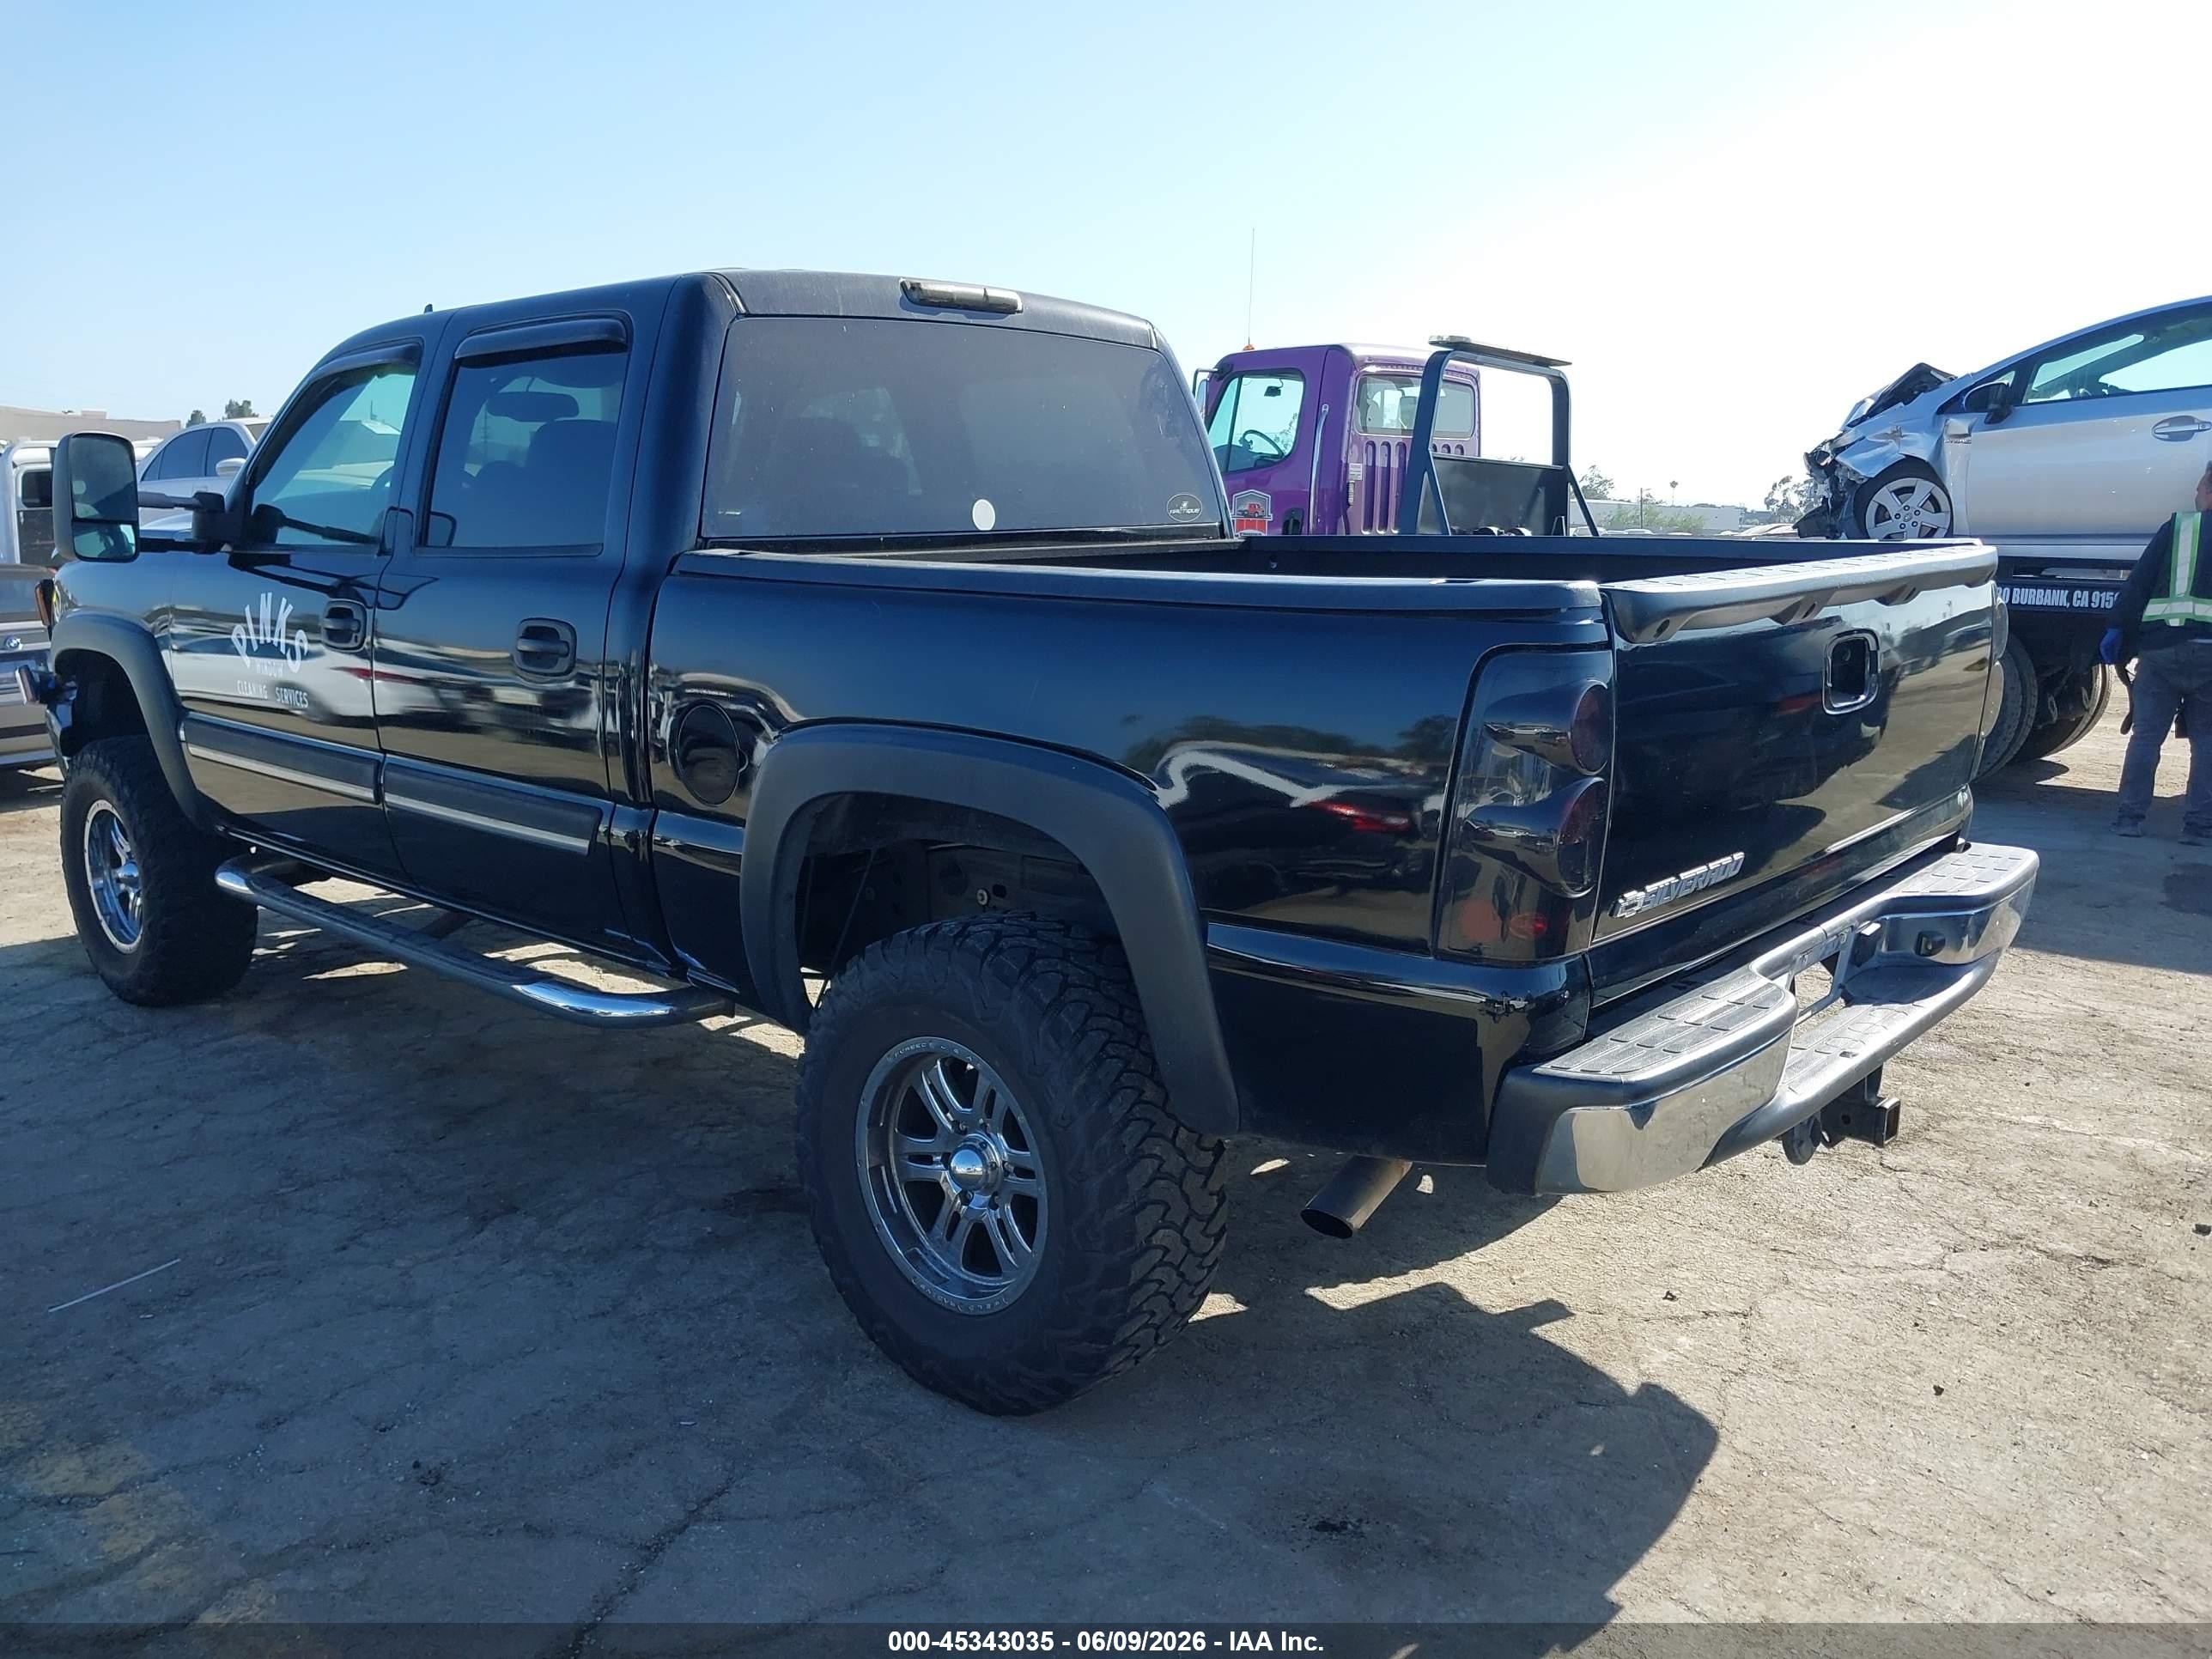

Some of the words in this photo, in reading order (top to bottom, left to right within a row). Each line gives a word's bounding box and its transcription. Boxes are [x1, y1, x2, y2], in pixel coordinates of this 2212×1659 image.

[2011, 587, 2069, 608] BURBANK,
[2072, 590, 2089, 607] CA
[231, 592, 308, 673] PINKS
[236, 679, 268, 699] CLEANING
[275, 686, 309, 708] SERVICES
[1638, 851, 1745, 913] SILVERADO
